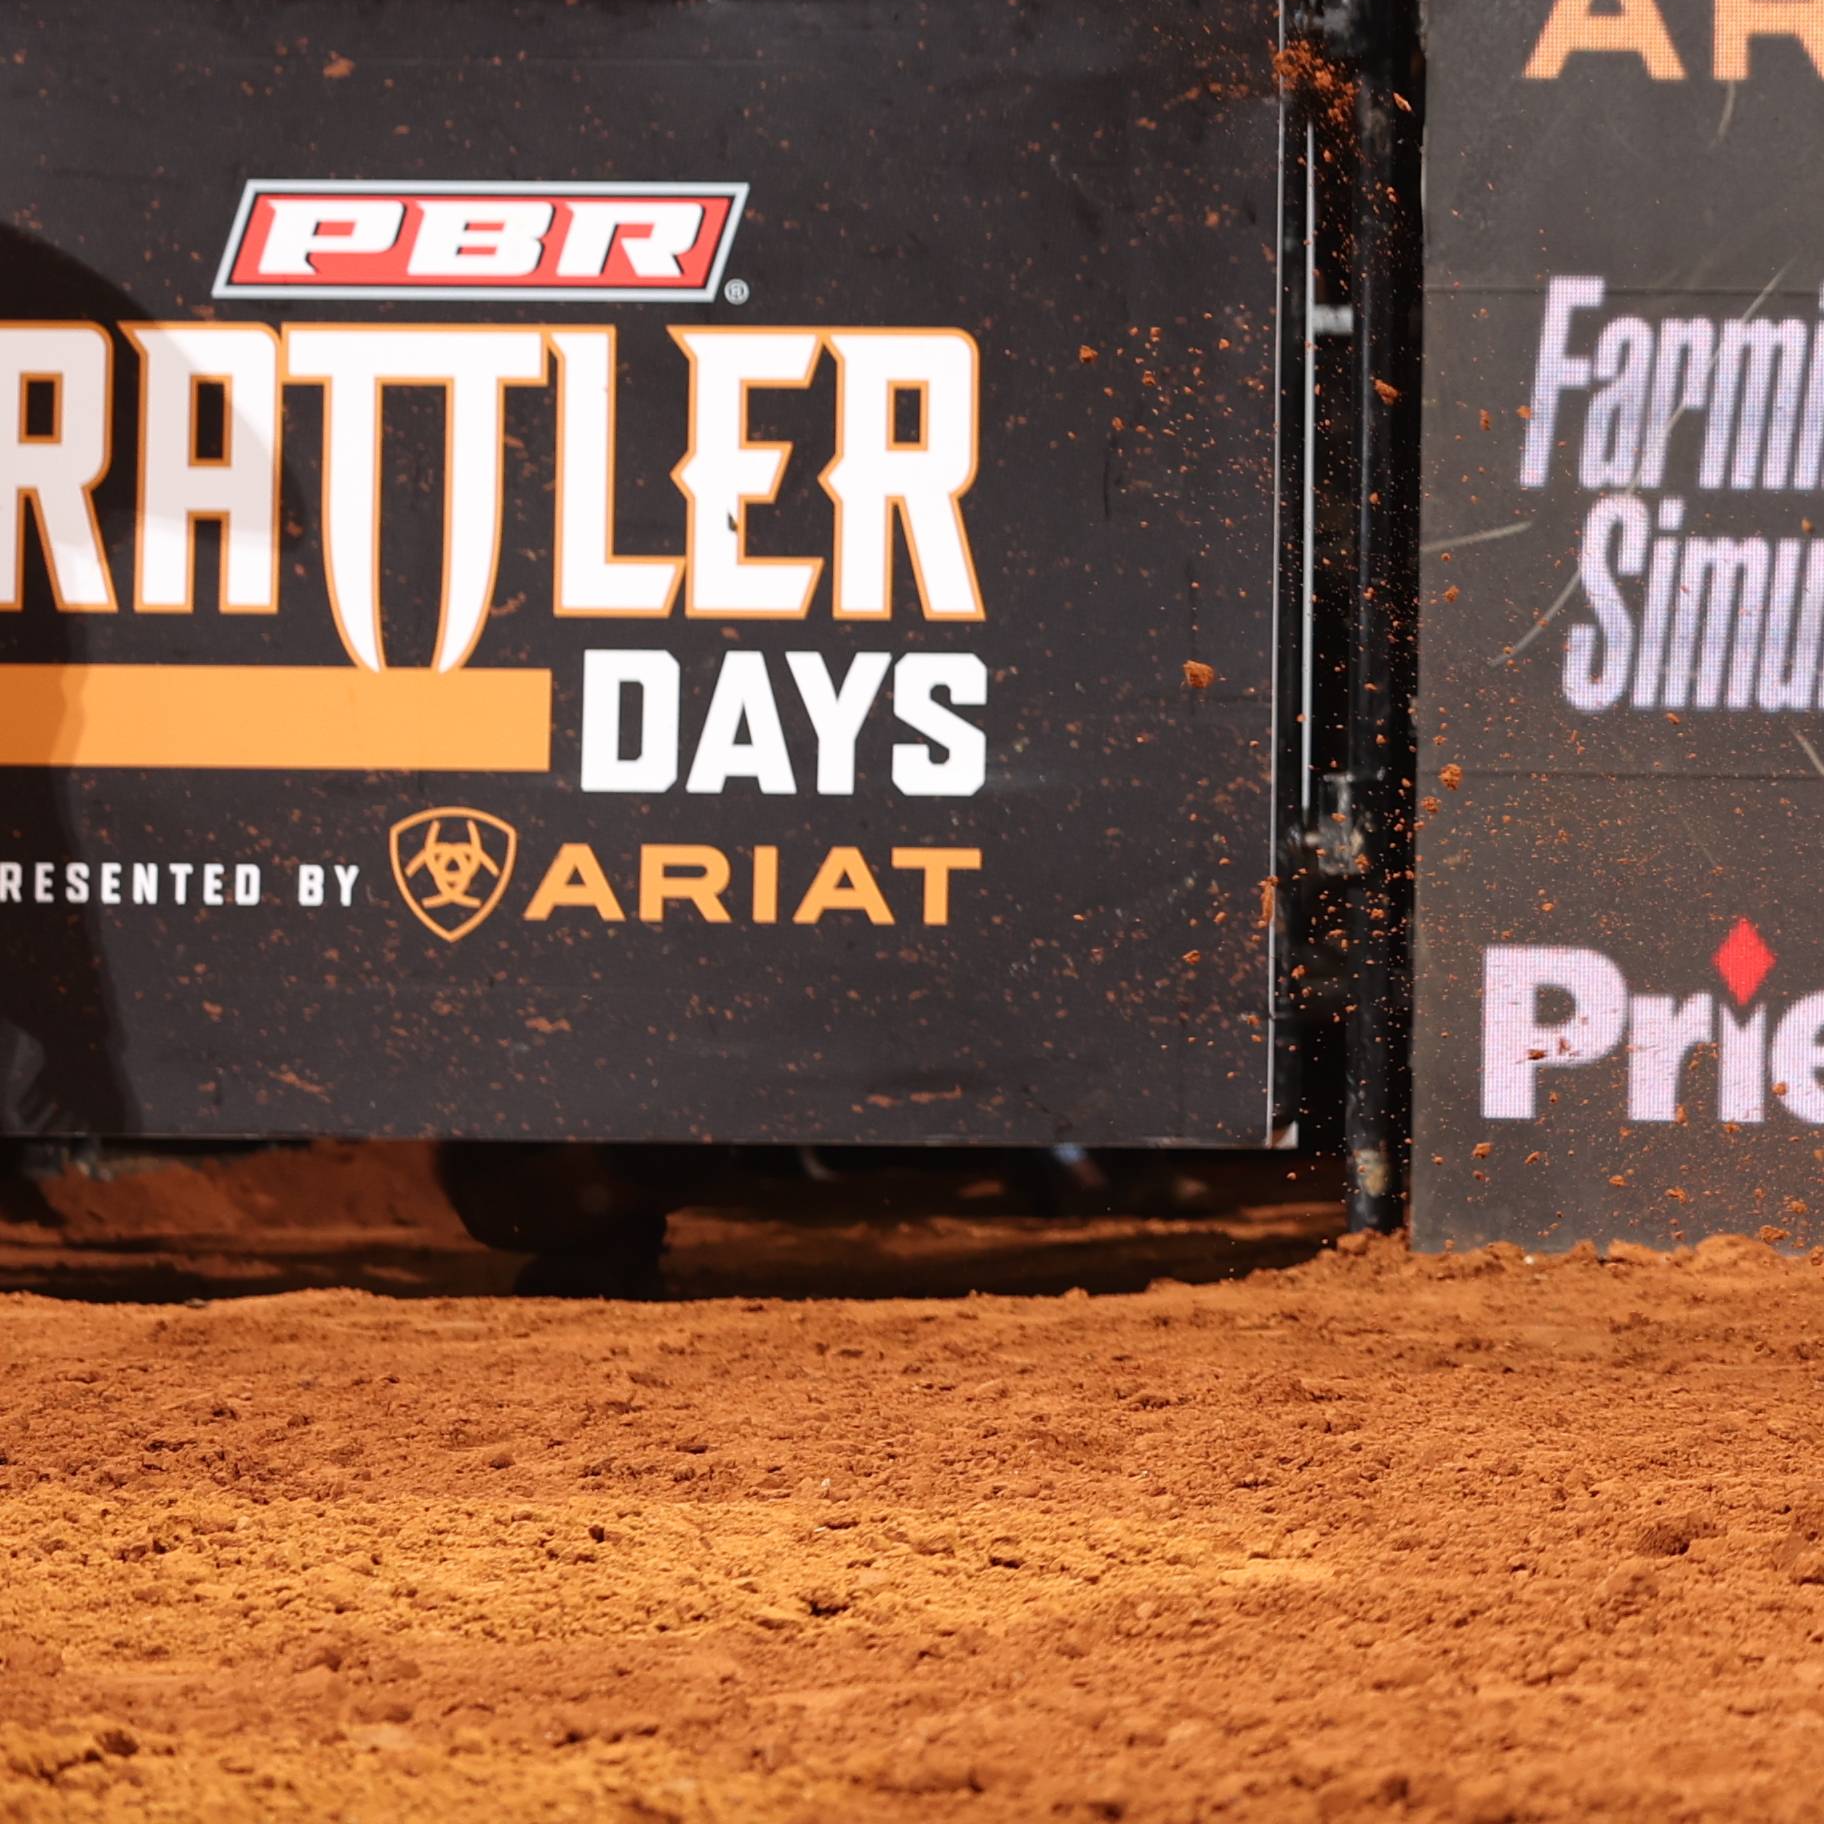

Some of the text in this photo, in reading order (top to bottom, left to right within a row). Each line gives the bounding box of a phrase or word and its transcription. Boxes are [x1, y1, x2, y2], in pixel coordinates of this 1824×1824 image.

[258, 198, 707, 278] PBR
[0, 321, 986, 673] RATTLER
[581, 648, 987, 796] DAYS
[0, 861, 360, 907] RESENTED BY
[523, 843, 983, 925] ARIAT
